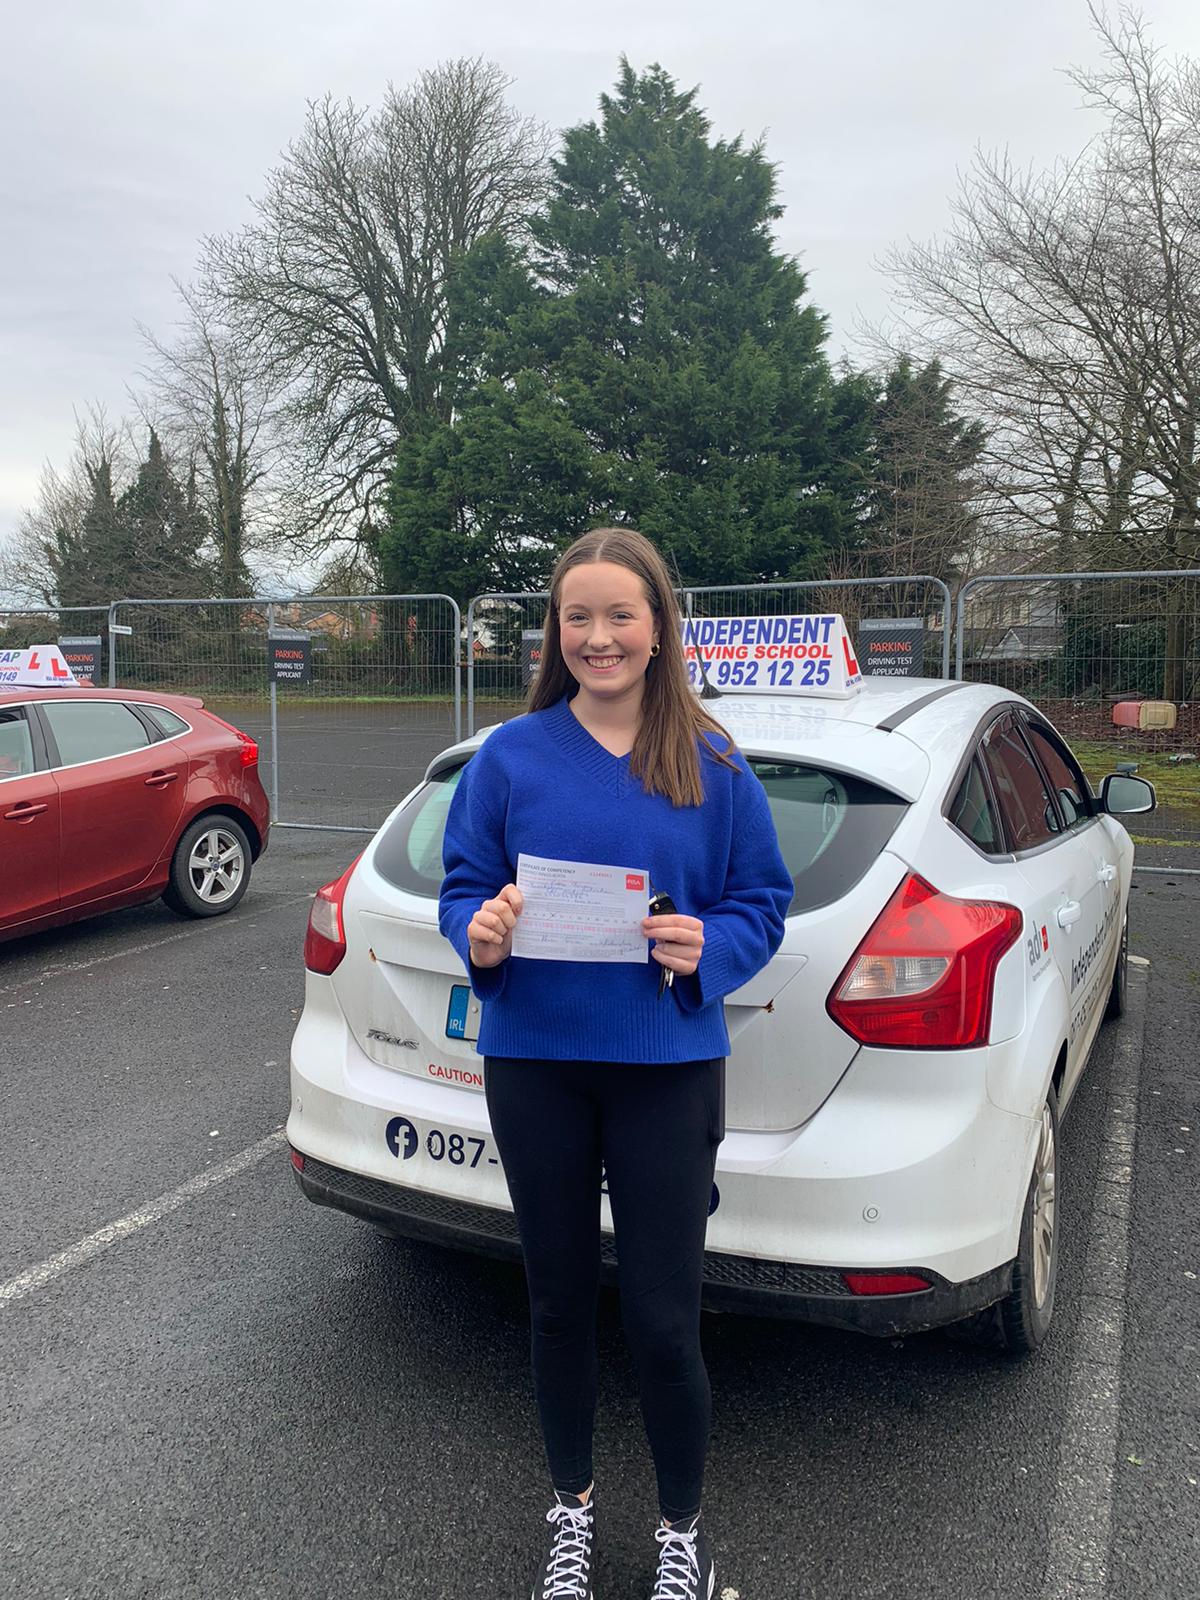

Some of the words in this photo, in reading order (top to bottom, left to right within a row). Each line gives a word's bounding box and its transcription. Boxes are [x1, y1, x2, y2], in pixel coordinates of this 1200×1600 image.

[684, 646, 748, 660] RIVING
[754, 645, 832, 659] SCHOOL
[870, 642, 912, 652] PARKING
[65, 654, 94, 662] PARKING
[275, 649, 304, 659] PARKING
[868, 657, 895, 665] DRIVING
[687, 661, 711, 686] 87
[717, 661, 759, 686] 952
[767, 661, 794, 686] 12
[800, 660, 830, 686] 25
[449, 1018, 464, 1032] IRL
[428, 1064, 483, 1086] CAUTION
